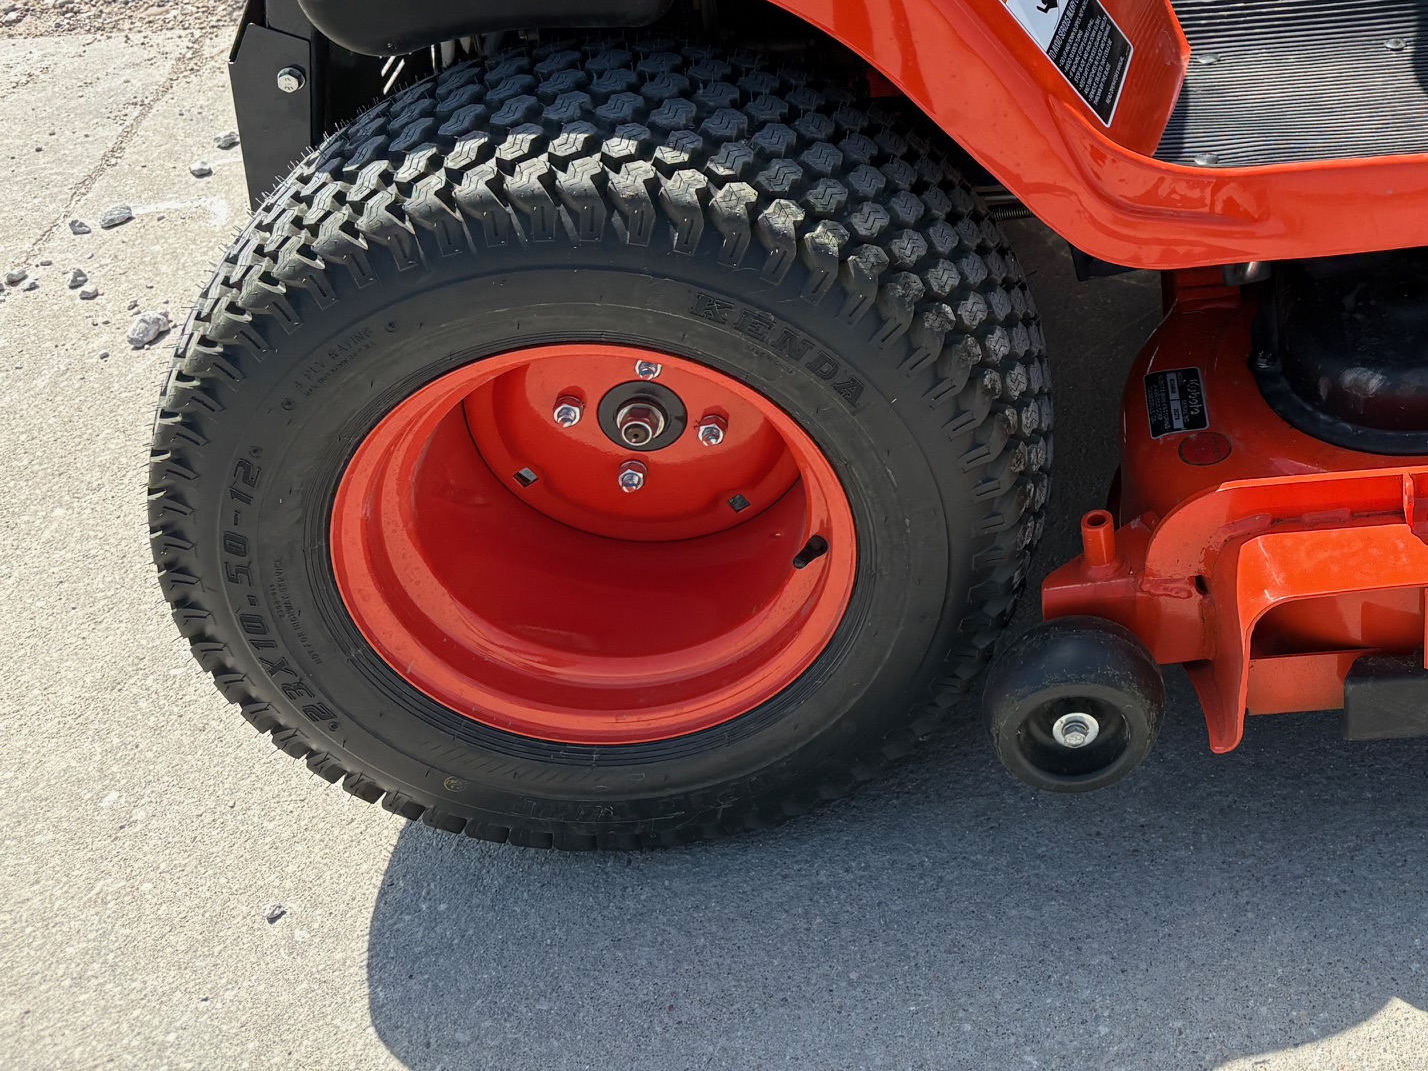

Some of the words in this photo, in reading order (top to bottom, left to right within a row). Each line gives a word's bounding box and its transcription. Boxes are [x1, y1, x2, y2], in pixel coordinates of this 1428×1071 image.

[328, 327, 374, 360] RATING
[689, 291, 866, 407] KENDA
[1186, 378, 1202, 415] Kubota
[272, 557, 288, 594] SERVICE
